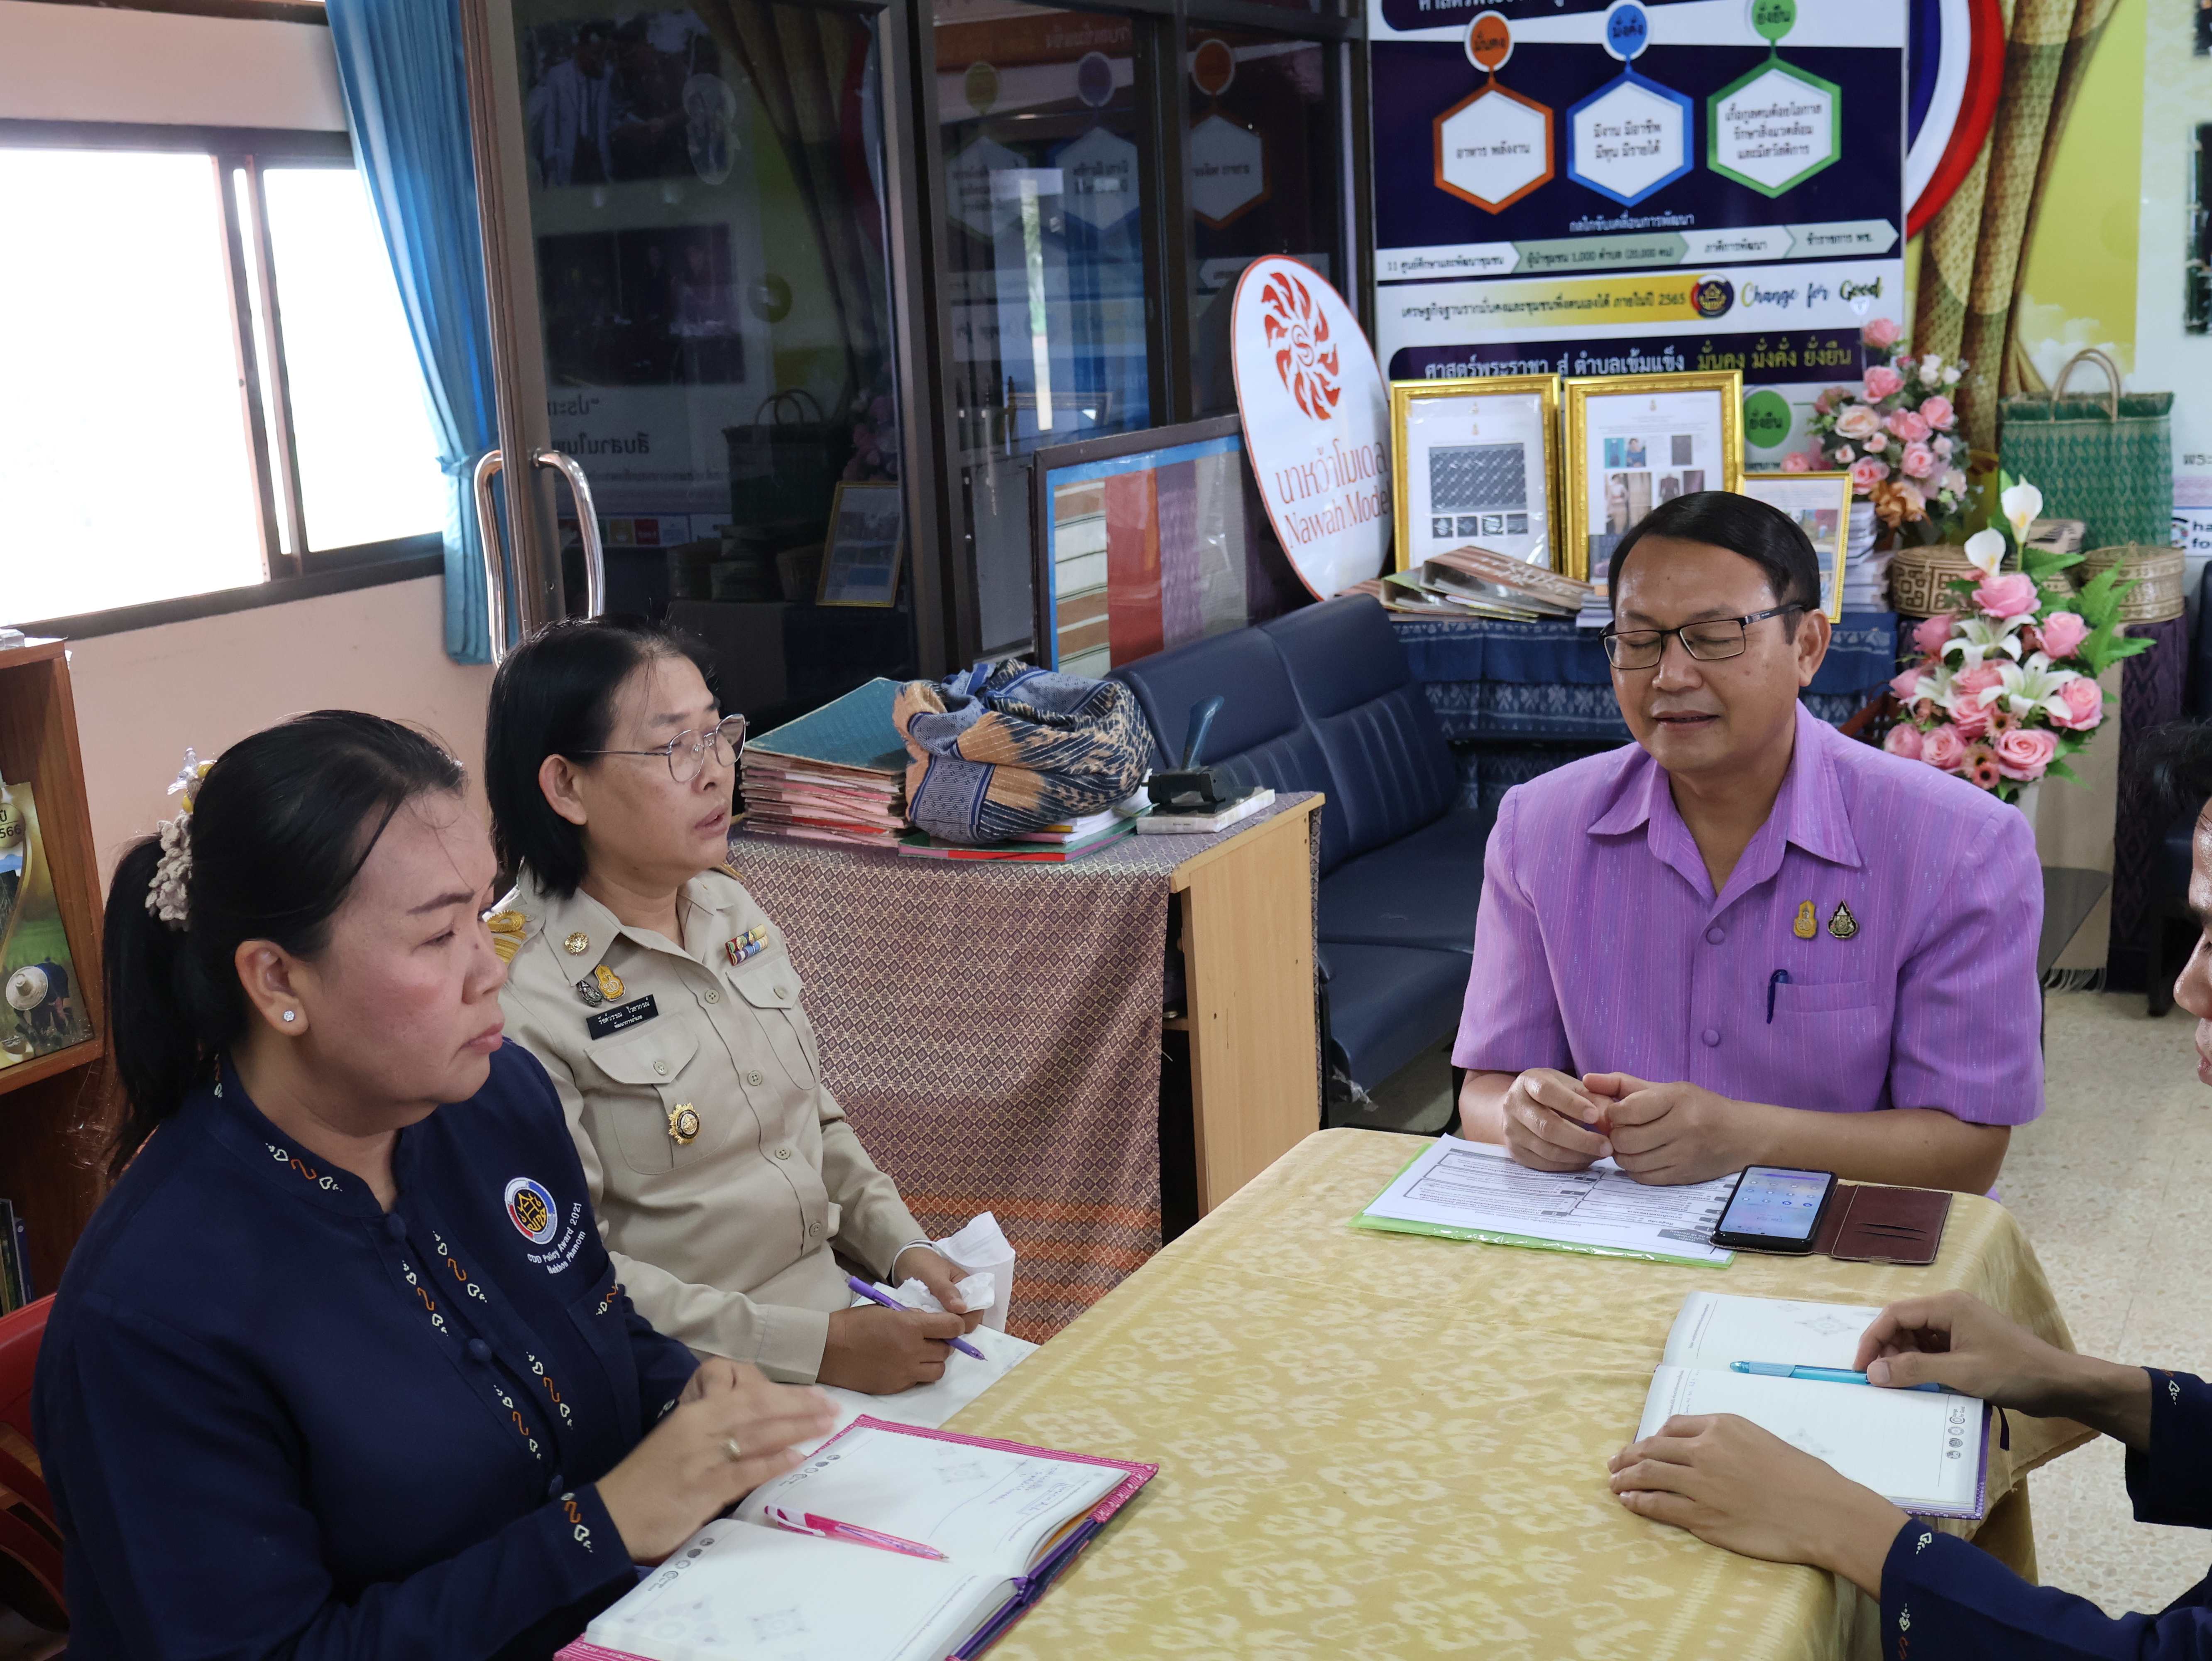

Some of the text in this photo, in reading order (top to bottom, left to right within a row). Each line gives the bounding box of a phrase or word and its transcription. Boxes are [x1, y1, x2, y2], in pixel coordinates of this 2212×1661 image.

[1658, 292, 1686, 306] 2565
[1741, 276, 1884, 309] Change for Good
[1574, 345, 1685, 375] ตำบลเข้มแข็ง
[1697, 338, 1744, 371] มั่นคง
[1752, 337, 1797, 368] มั่งคั่ง
[1803, 334, 1852, 366] ยั่งยืน
[1275, 439, 1388, 504] นาหว้าโมเดล
[1284, 498, 1346, 549] Nawah
[527, 1202, 582, 1264] CDD Policy Award 2021
[546, 1230, 586, 1274] Nakhon Phanom
